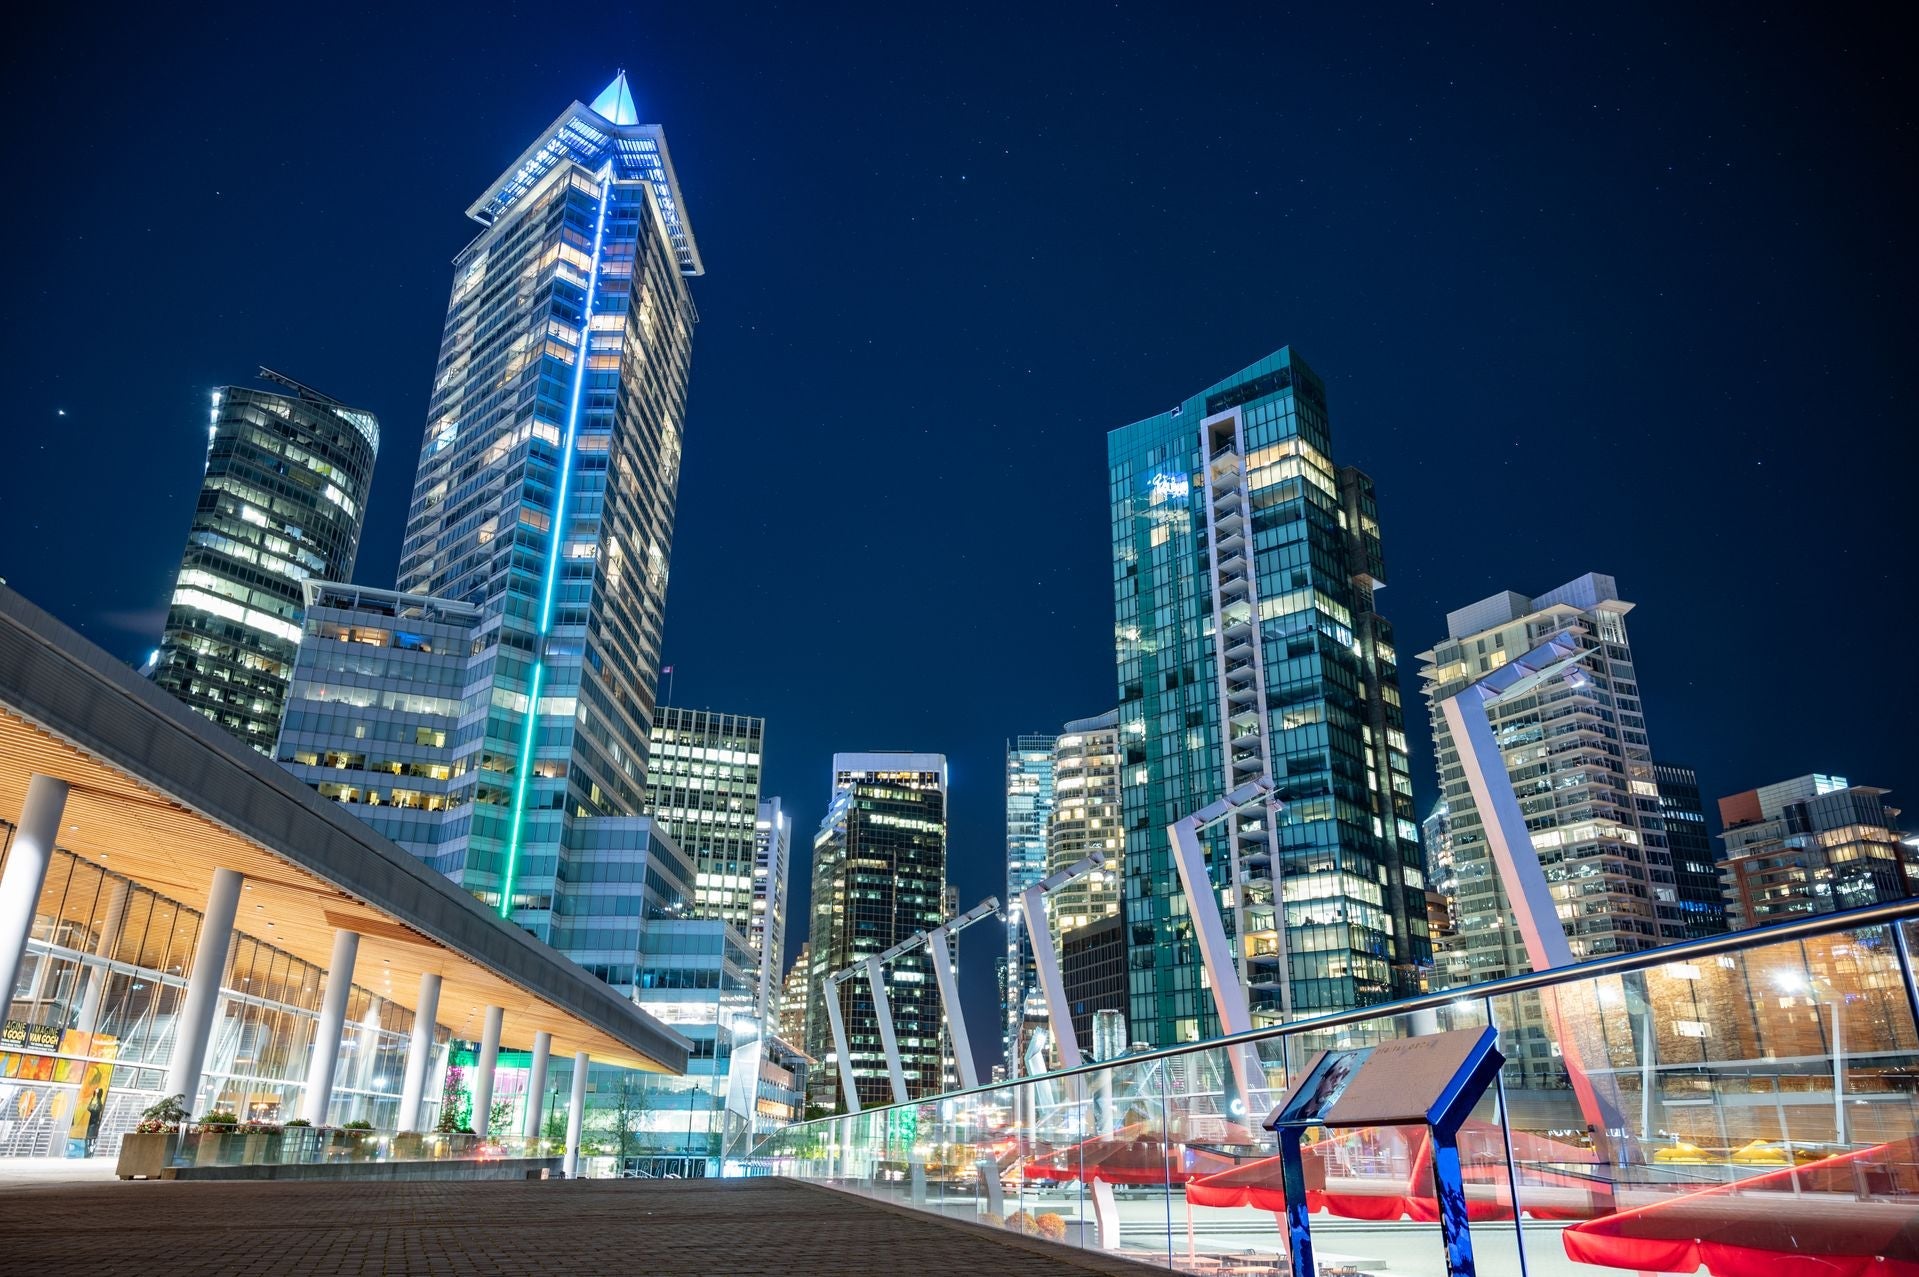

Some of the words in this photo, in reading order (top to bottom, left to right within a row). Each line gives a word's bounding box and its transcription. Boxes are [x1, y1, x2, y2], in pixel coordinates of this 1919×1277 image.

[7, 1030, 27, 1041] GOGH
[29, 1033, 42, 1043] VAN
[41, 1035, 59, 1046] GOGH
